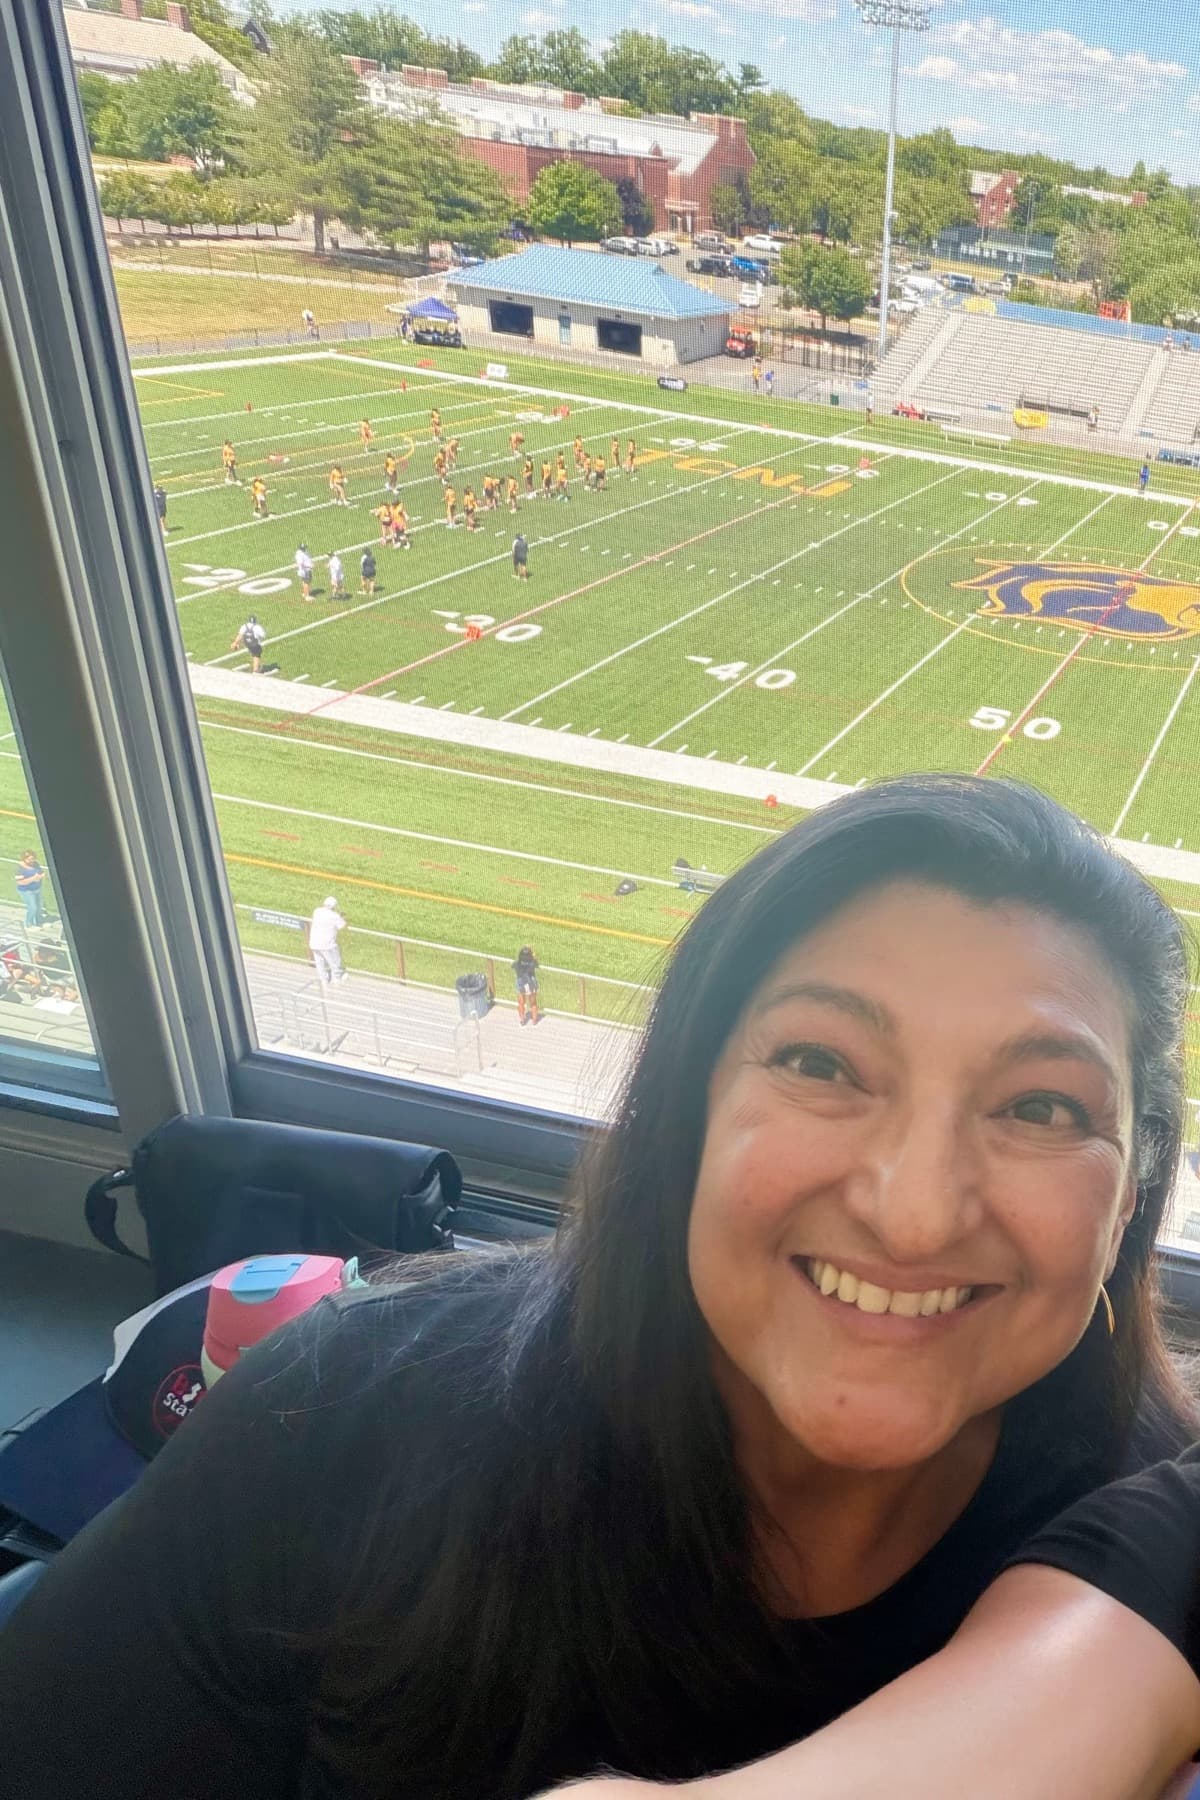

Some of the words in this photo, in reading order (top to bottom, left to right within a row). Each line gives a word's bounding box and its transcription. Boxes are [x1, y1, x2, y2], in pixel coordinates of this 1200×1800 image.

[181, 567, 293, 595] 20
[704, 660, 798, 690] 40
[968, 705, 1062, 741] 50
